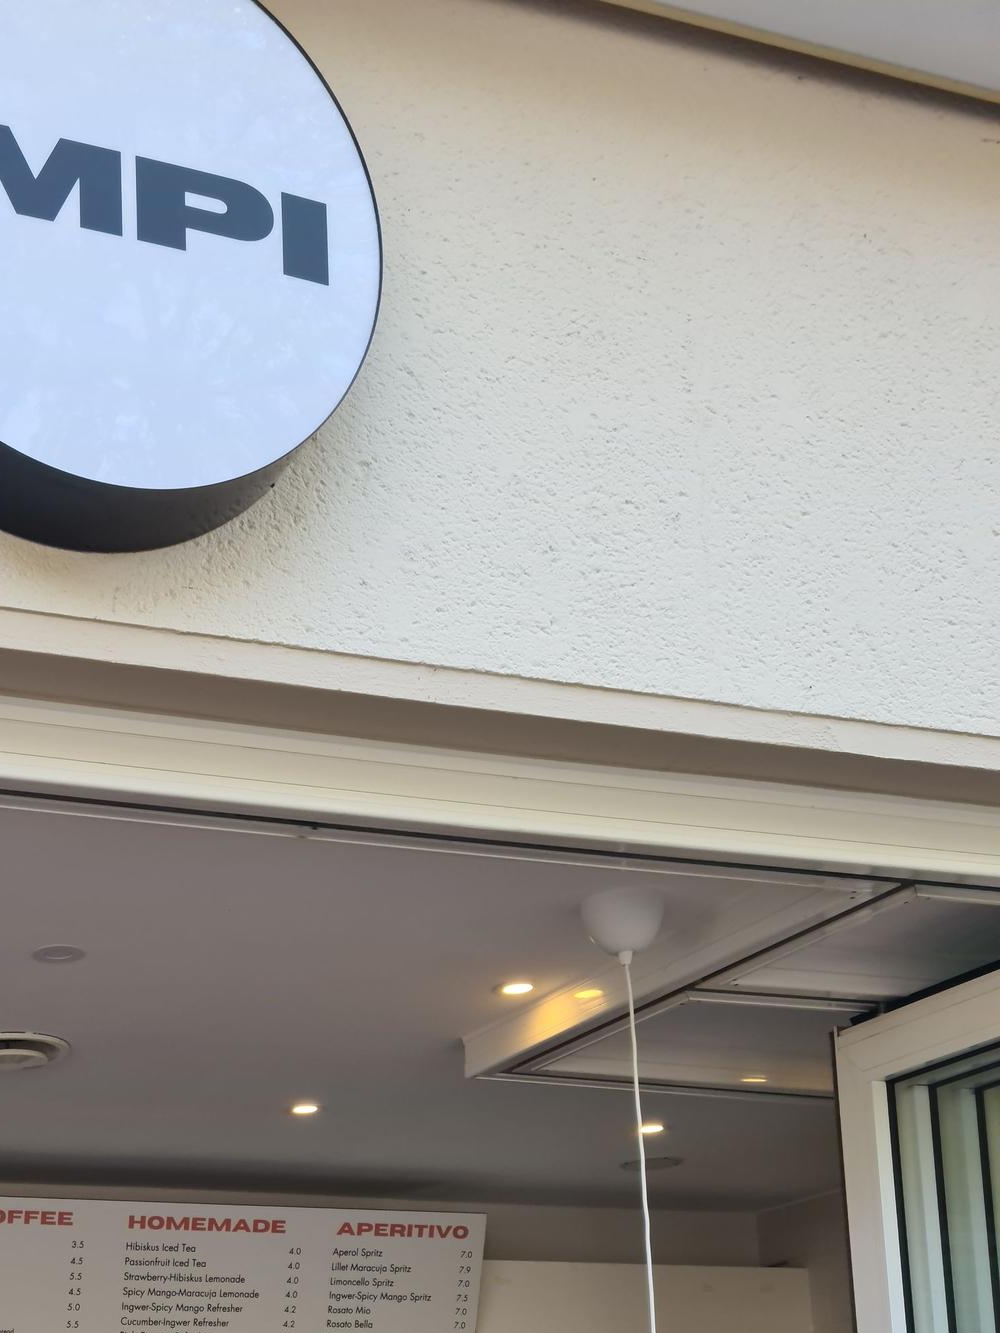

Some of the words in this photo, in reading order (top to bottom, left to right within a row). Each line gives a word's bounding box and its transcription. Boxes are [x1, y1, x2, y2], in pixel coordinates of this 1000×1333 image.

[128, 1215, 286, 1233] HOMEMADE
[337, 1222, 469, 1239] APERITIVO
[126, 1242, 159, 1251] Hibiskus
[163, 1243, 179, 1252] Iced
[182, 1244, 196, 1252] Tea
[333, 1248, 359, 1258] Aperol
[361, 1249, 382, 1259] Spritz
[125, 1257, 170, 1267] Passionfruit
[173, 1258, 189, 1267] Iced
[192, 1259, 206, 1267] Tea
[332, 1263, 348, 1271] Lillet
[351, 1264, 387, 1274] Maracuja
[390, 1265, 411, 1274] Spritz
[70, 1273, 82, 1281] 5.5
[124, 1272, 202, 1284] Strawberry-Hibiskus
[205, 1274, 245, 1284] Lemonade
[330, 1278, 369, 1286] Limoncello
[372, 1278, 394, 1288] Spritz
[69, 1288, 81, 1296] 4.5
[123, 1287, 145, 1298] Spicy
[147, 1288, 217, 1299] Mango-Maracuja
[220, 1289, 259, 1298] Lemonade
[329, 1292, 378, 1302] Ingwer-Spicy
[380, 1293, 407, 1303] Mango
[410, 1293, 431, 1302] Spritz
[122, 1302, 173, 1313] Ingwer-Spicy
[176, 1304, 204, 1314] Mango
[207, 1304, 243, 1313] Refresher
[328, 1306, 353, 1314] Rosato
[356, 1306, 371, 1314] Mio
[121, 1317, 190, 1329] Cucumber-Ingwer
[193, 1319, 229, 1327] Refresher
[327, 1320, 352, 1328] Rosato
[355, 1320, 373, 1328] Bella
